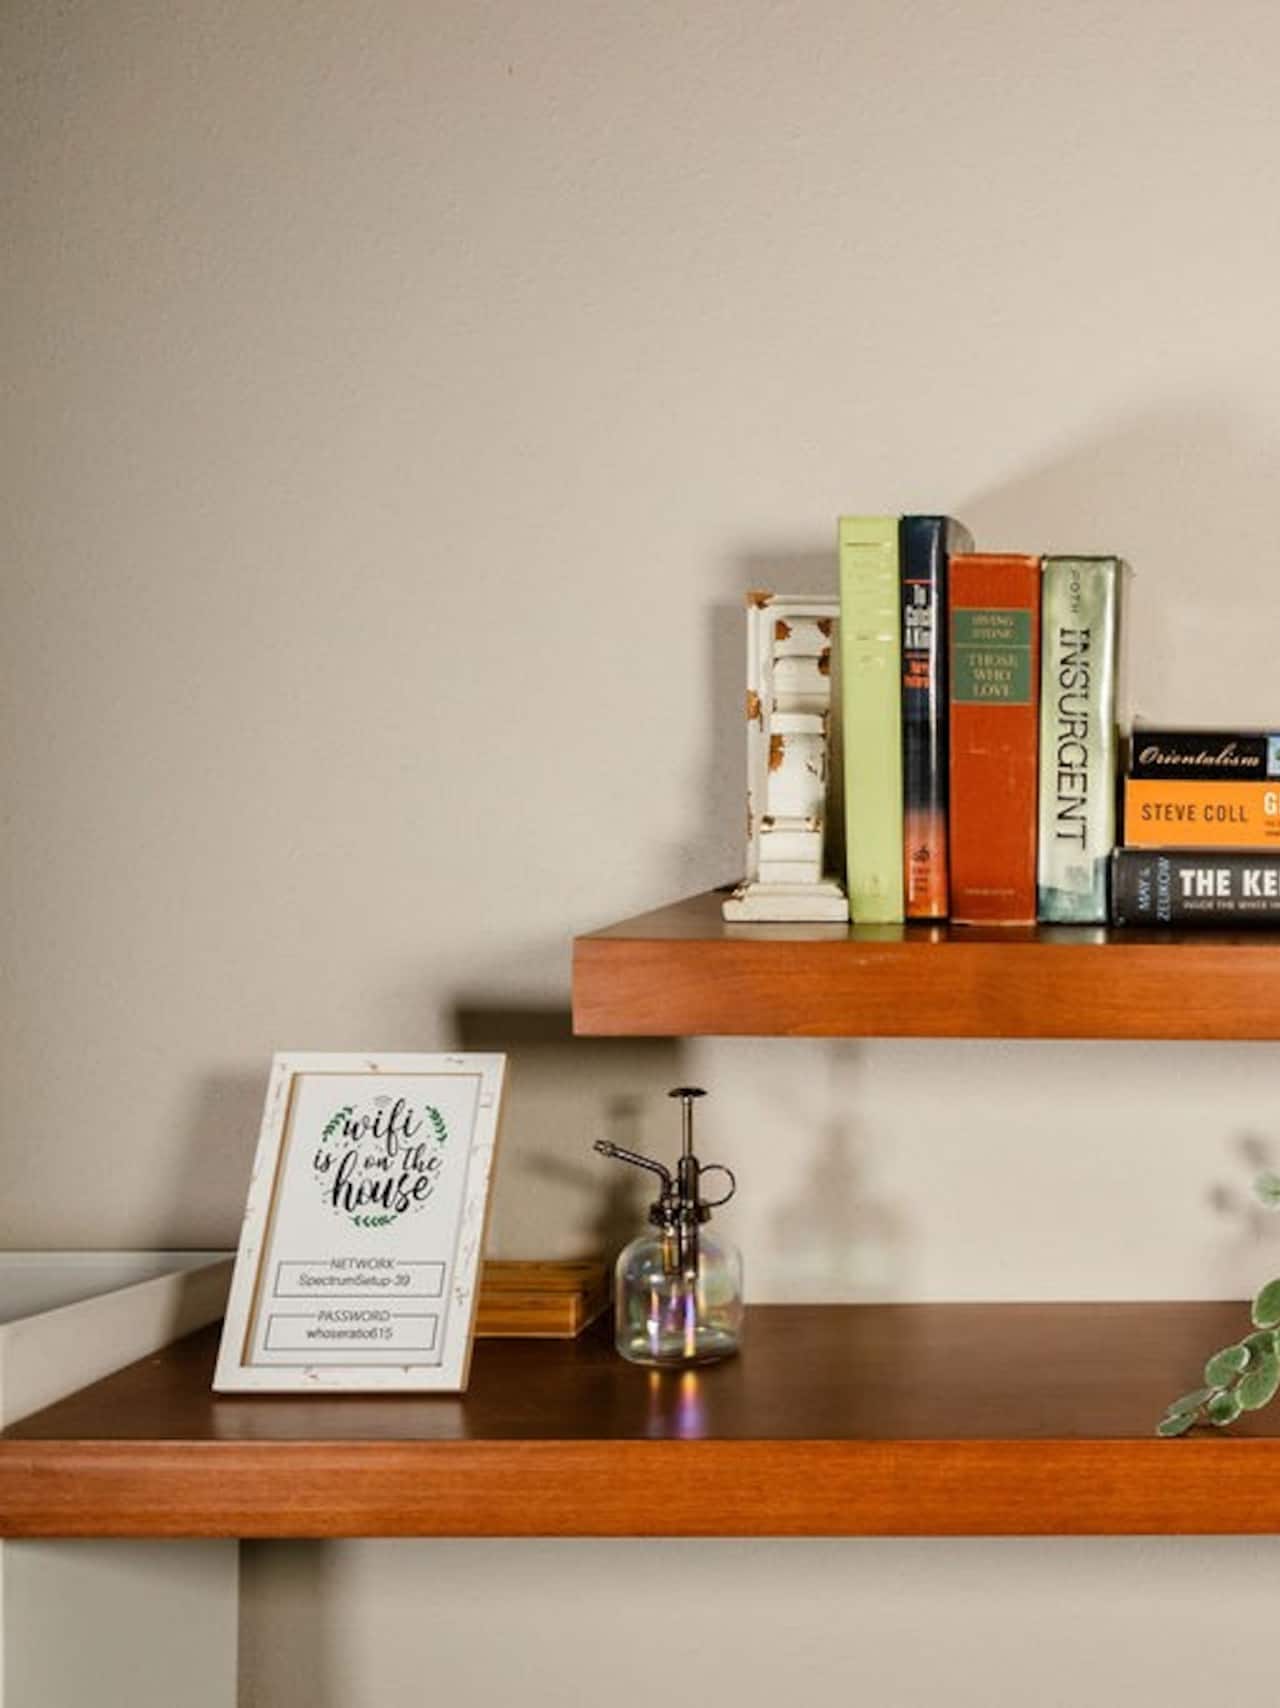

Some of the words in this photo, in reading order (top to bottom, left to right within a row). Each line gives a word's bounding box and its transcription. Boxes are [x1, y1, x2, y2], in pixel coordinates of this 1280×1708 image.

[973, 669, 1012, 681] WHO
[1056, 628, 1091, 849] INSURGENT
[1138, 743, 1260, 768] Orientalism
[1141, 804, 1196, 821] STEVE
[1204, 805, 1249, 822] COLL
[1138, 877, 1150, 911] MAY
[1179, 869, 1231, 897] THE
[342, 1098, 423, 1157] wifi
[313, 1149, 337, 1173] is
[364, 1155, 395, 1172] on
[400, 1143, 443, 1173] the
[322, 1150, 434, 1213] house
[330, 1257, 397, 1269] NETWORK
[316, 1310, 391, 1322] PASSWORD
